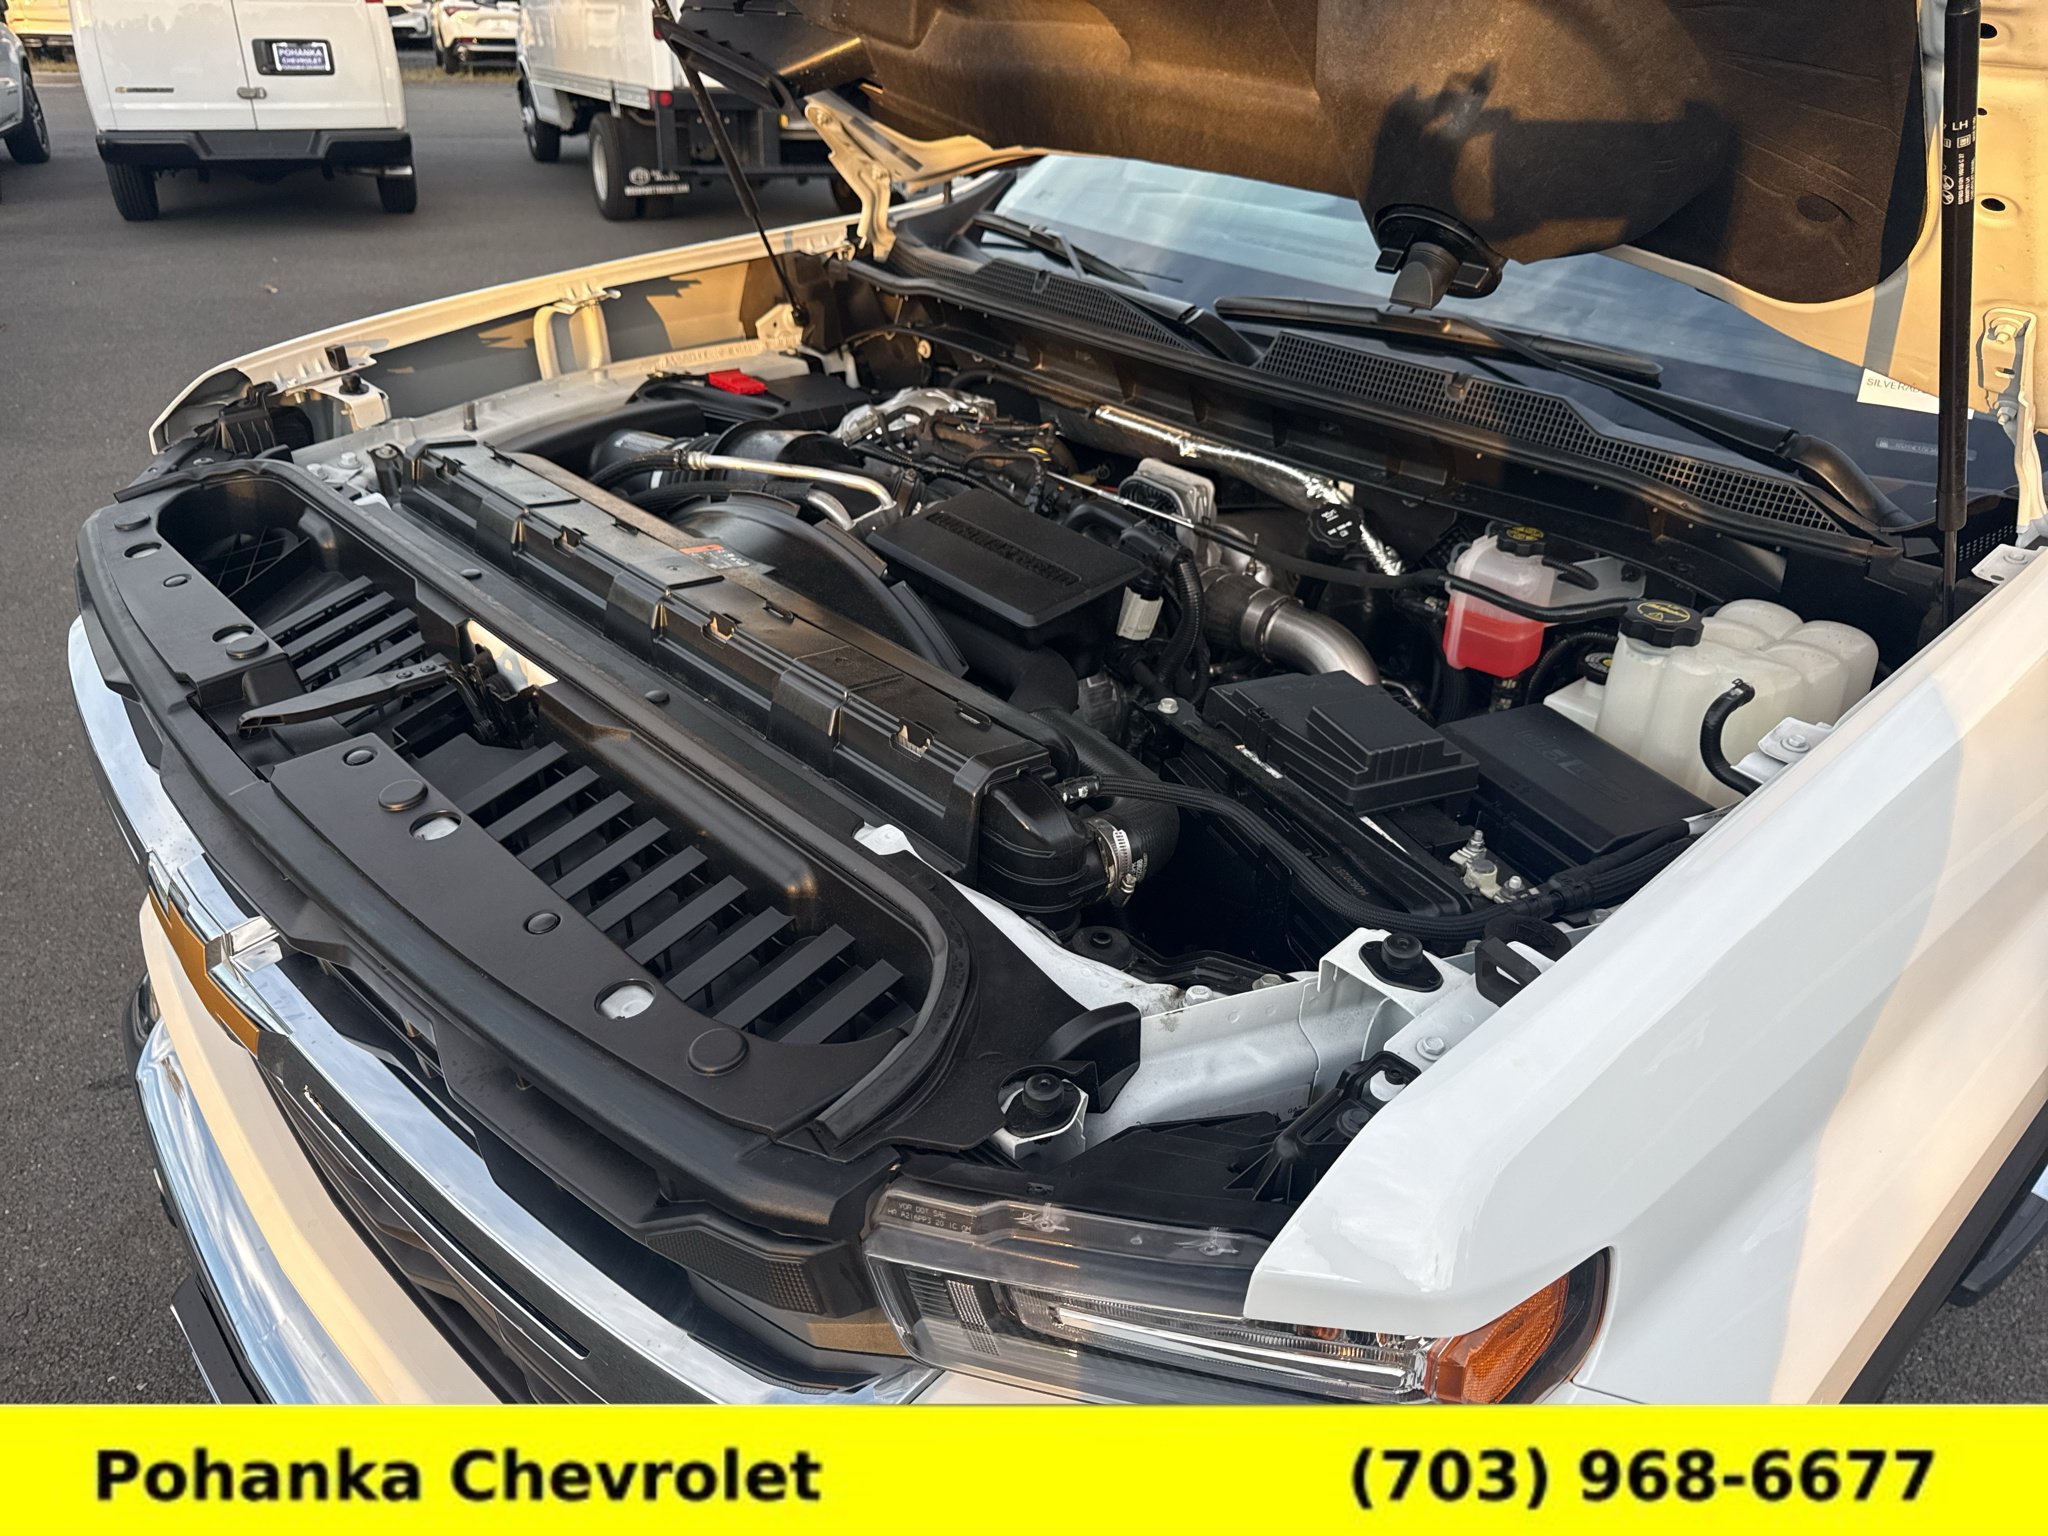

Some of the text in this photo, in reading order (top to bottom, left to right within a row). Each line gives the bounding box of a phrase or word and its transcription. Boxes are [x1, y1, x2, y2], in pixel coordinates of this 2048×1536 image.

[279, 48, 322, 56] POHANKA
[1952, 120, 1968, 131] LH
[1866, 378, 1920, 394] SILVERAD
[916, 1206, 929, 1214] DOT
[933, 1210, 947, 1219] SAE
